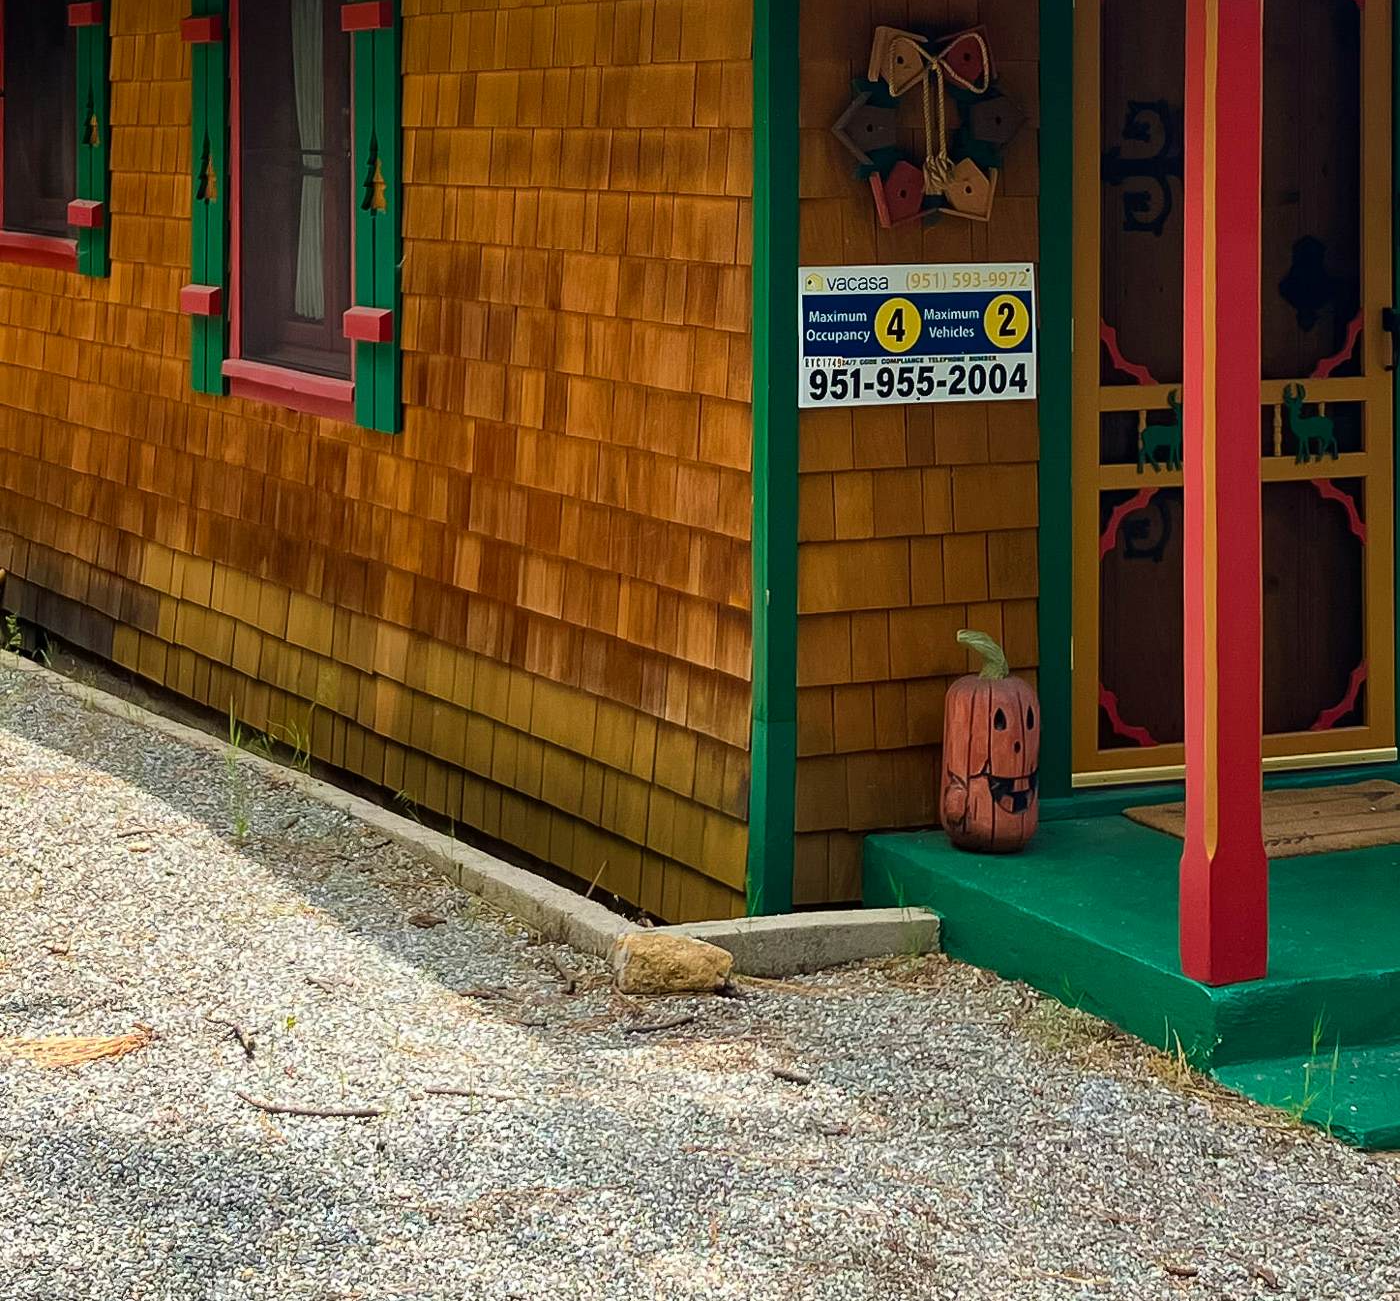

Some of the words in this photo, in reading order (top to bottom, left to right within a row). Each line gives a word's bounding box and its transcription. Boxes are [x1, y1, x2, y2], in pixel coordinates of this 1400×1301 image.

[826, 276, 889, 292] vacasa
[906, 271, 946, 291] (951)
[952, 271, 1028, 289] 593-9972
[808, 310, 867, 323] Maximum
[924, 308, 980, 320] Maximum
[998, 302, 1017, 337] 2
[886, 308, 905, 342] 4
[929, 326, 975, 338] Vehicles
[806, 329, 871, 344] Occupancy
[928, 355, 965, 363] TELEPHONE
[809, 363, 1027, 400] 951-955-2004
